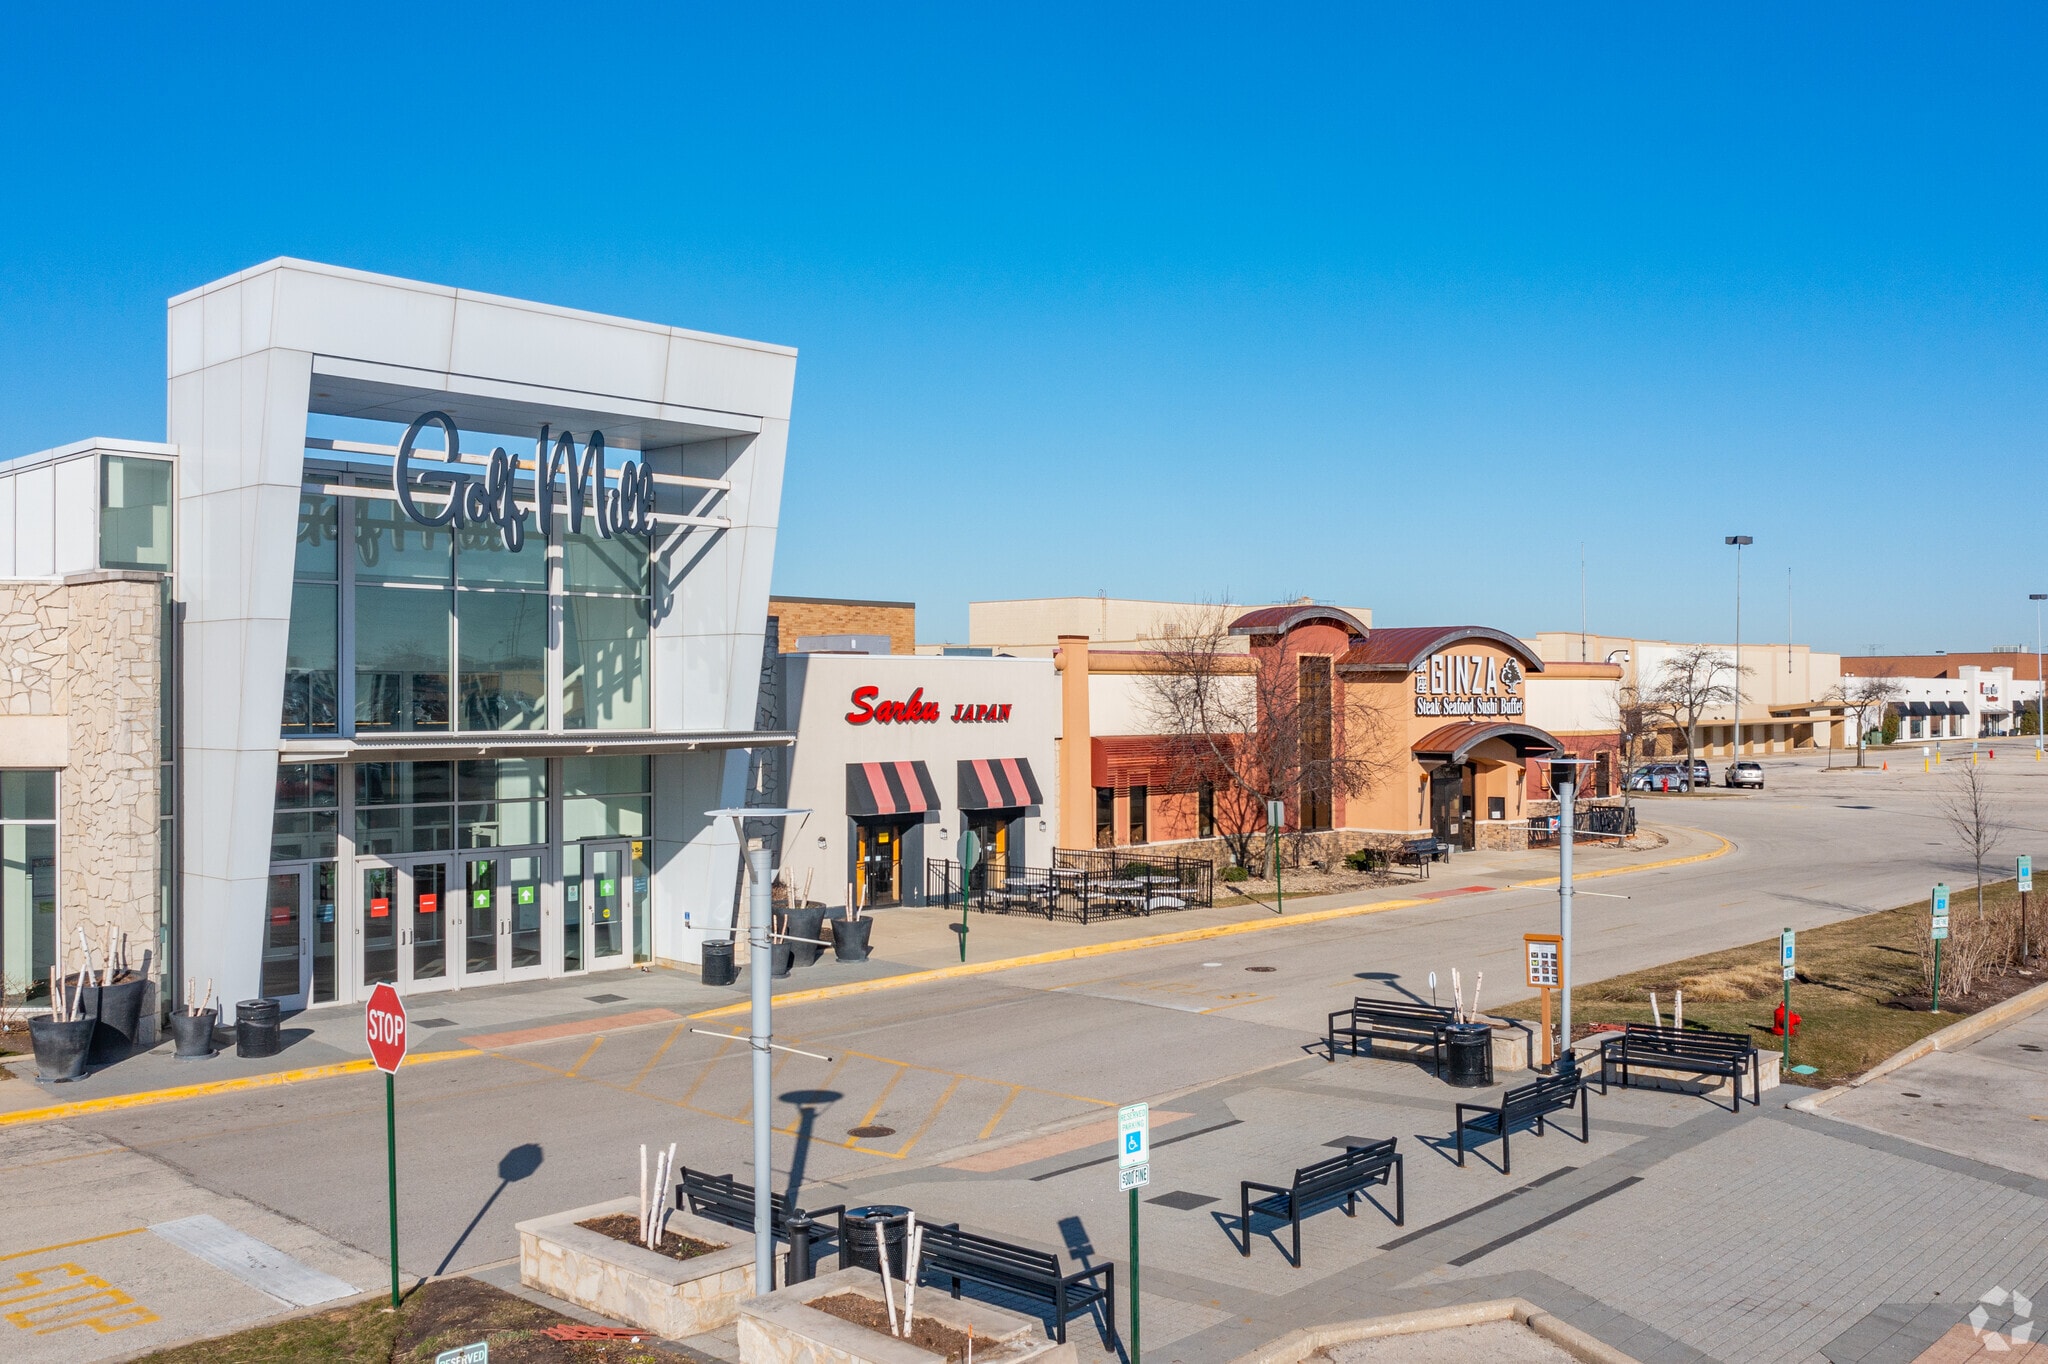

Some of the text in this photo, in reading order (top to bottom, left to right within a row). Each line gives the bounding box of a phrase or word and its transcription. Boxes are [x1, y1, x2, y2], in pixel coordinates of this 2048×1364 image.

[394, 410, 529, 553] Golf
[535, 424, 657, 539] Mill
[1431, 655, 1498, 695] GINZA
[847, 685, 1012, 724] Sarku JAPAN
[1416, 697, 1524, 715] Steak Seafood Sushi Buffet
[369, 1009, 404, 1047] STOP
[1120, 1109, 1146, 1121] RESERVED
[1122, 1119, 1145, 1131] PARKING
[1135, 1167, 1147, 1183] FINE
